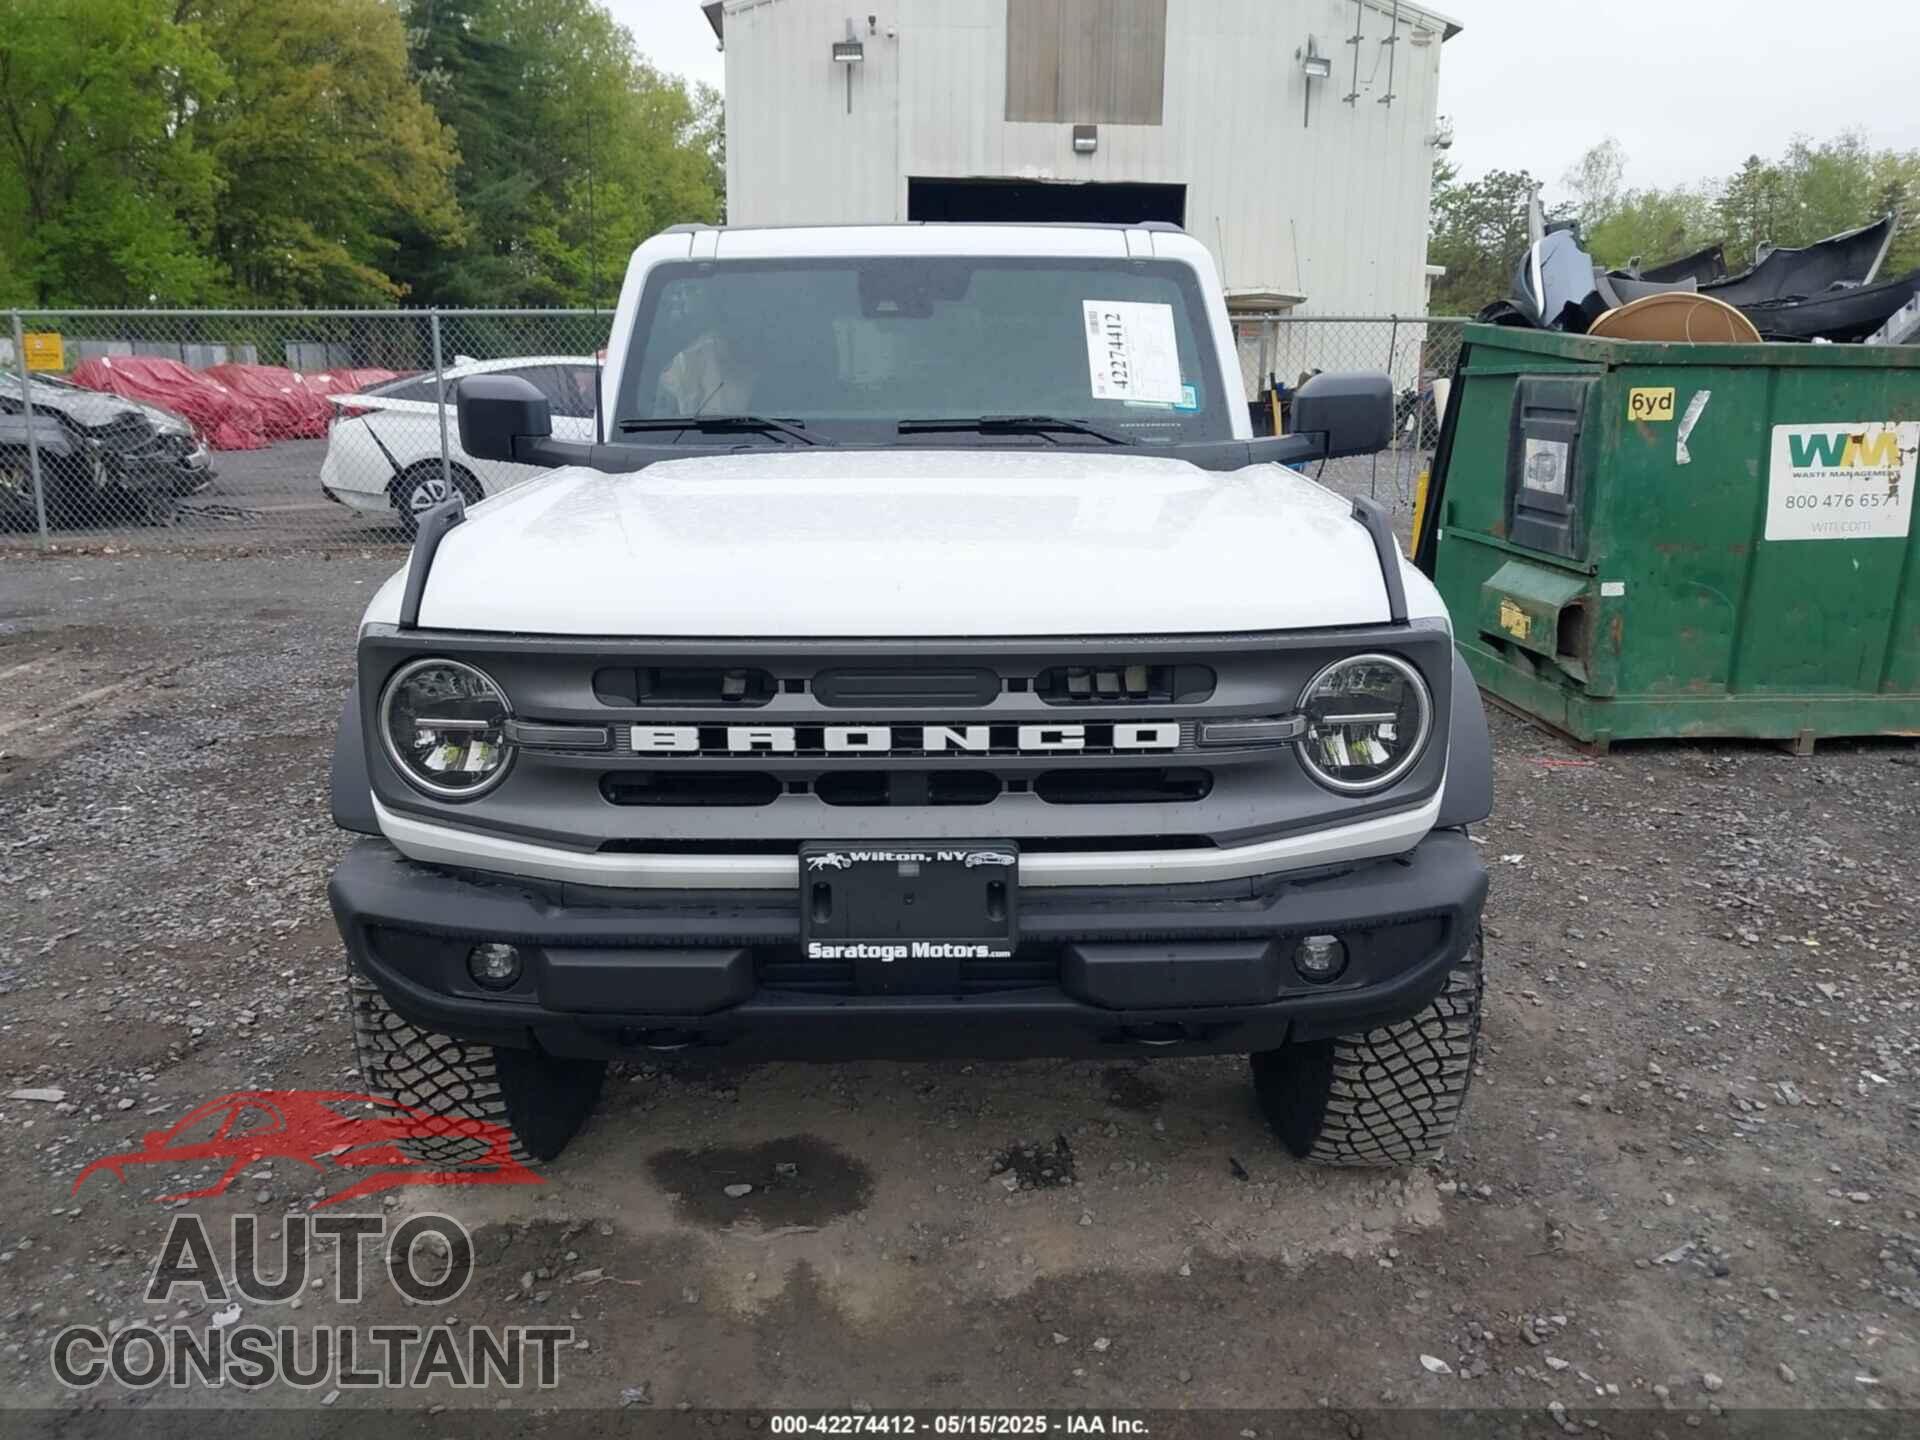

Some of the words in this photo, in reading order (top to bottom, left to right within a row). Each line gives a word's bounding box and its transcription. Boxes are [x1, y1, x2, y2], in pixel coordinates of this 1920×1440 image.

[1104, 312, 1128, 390] 42274412
[1632, 392, 1672, 415] 6yd
[1788, 432, 1900, 468] WM
[1785, 495, 1817, 509] 800
[1823, 494, 1854, 507] 476
[1860, 493, 1899, 507] 6571
[1810, 520, 1871, 532] wm.com
[630, 723, 1180, 751] BRONCO
[850, 851, 932, 862] Wilton,
[937, 851, 968, 861] NY
[808, 942, 907, 962] Saratoga
